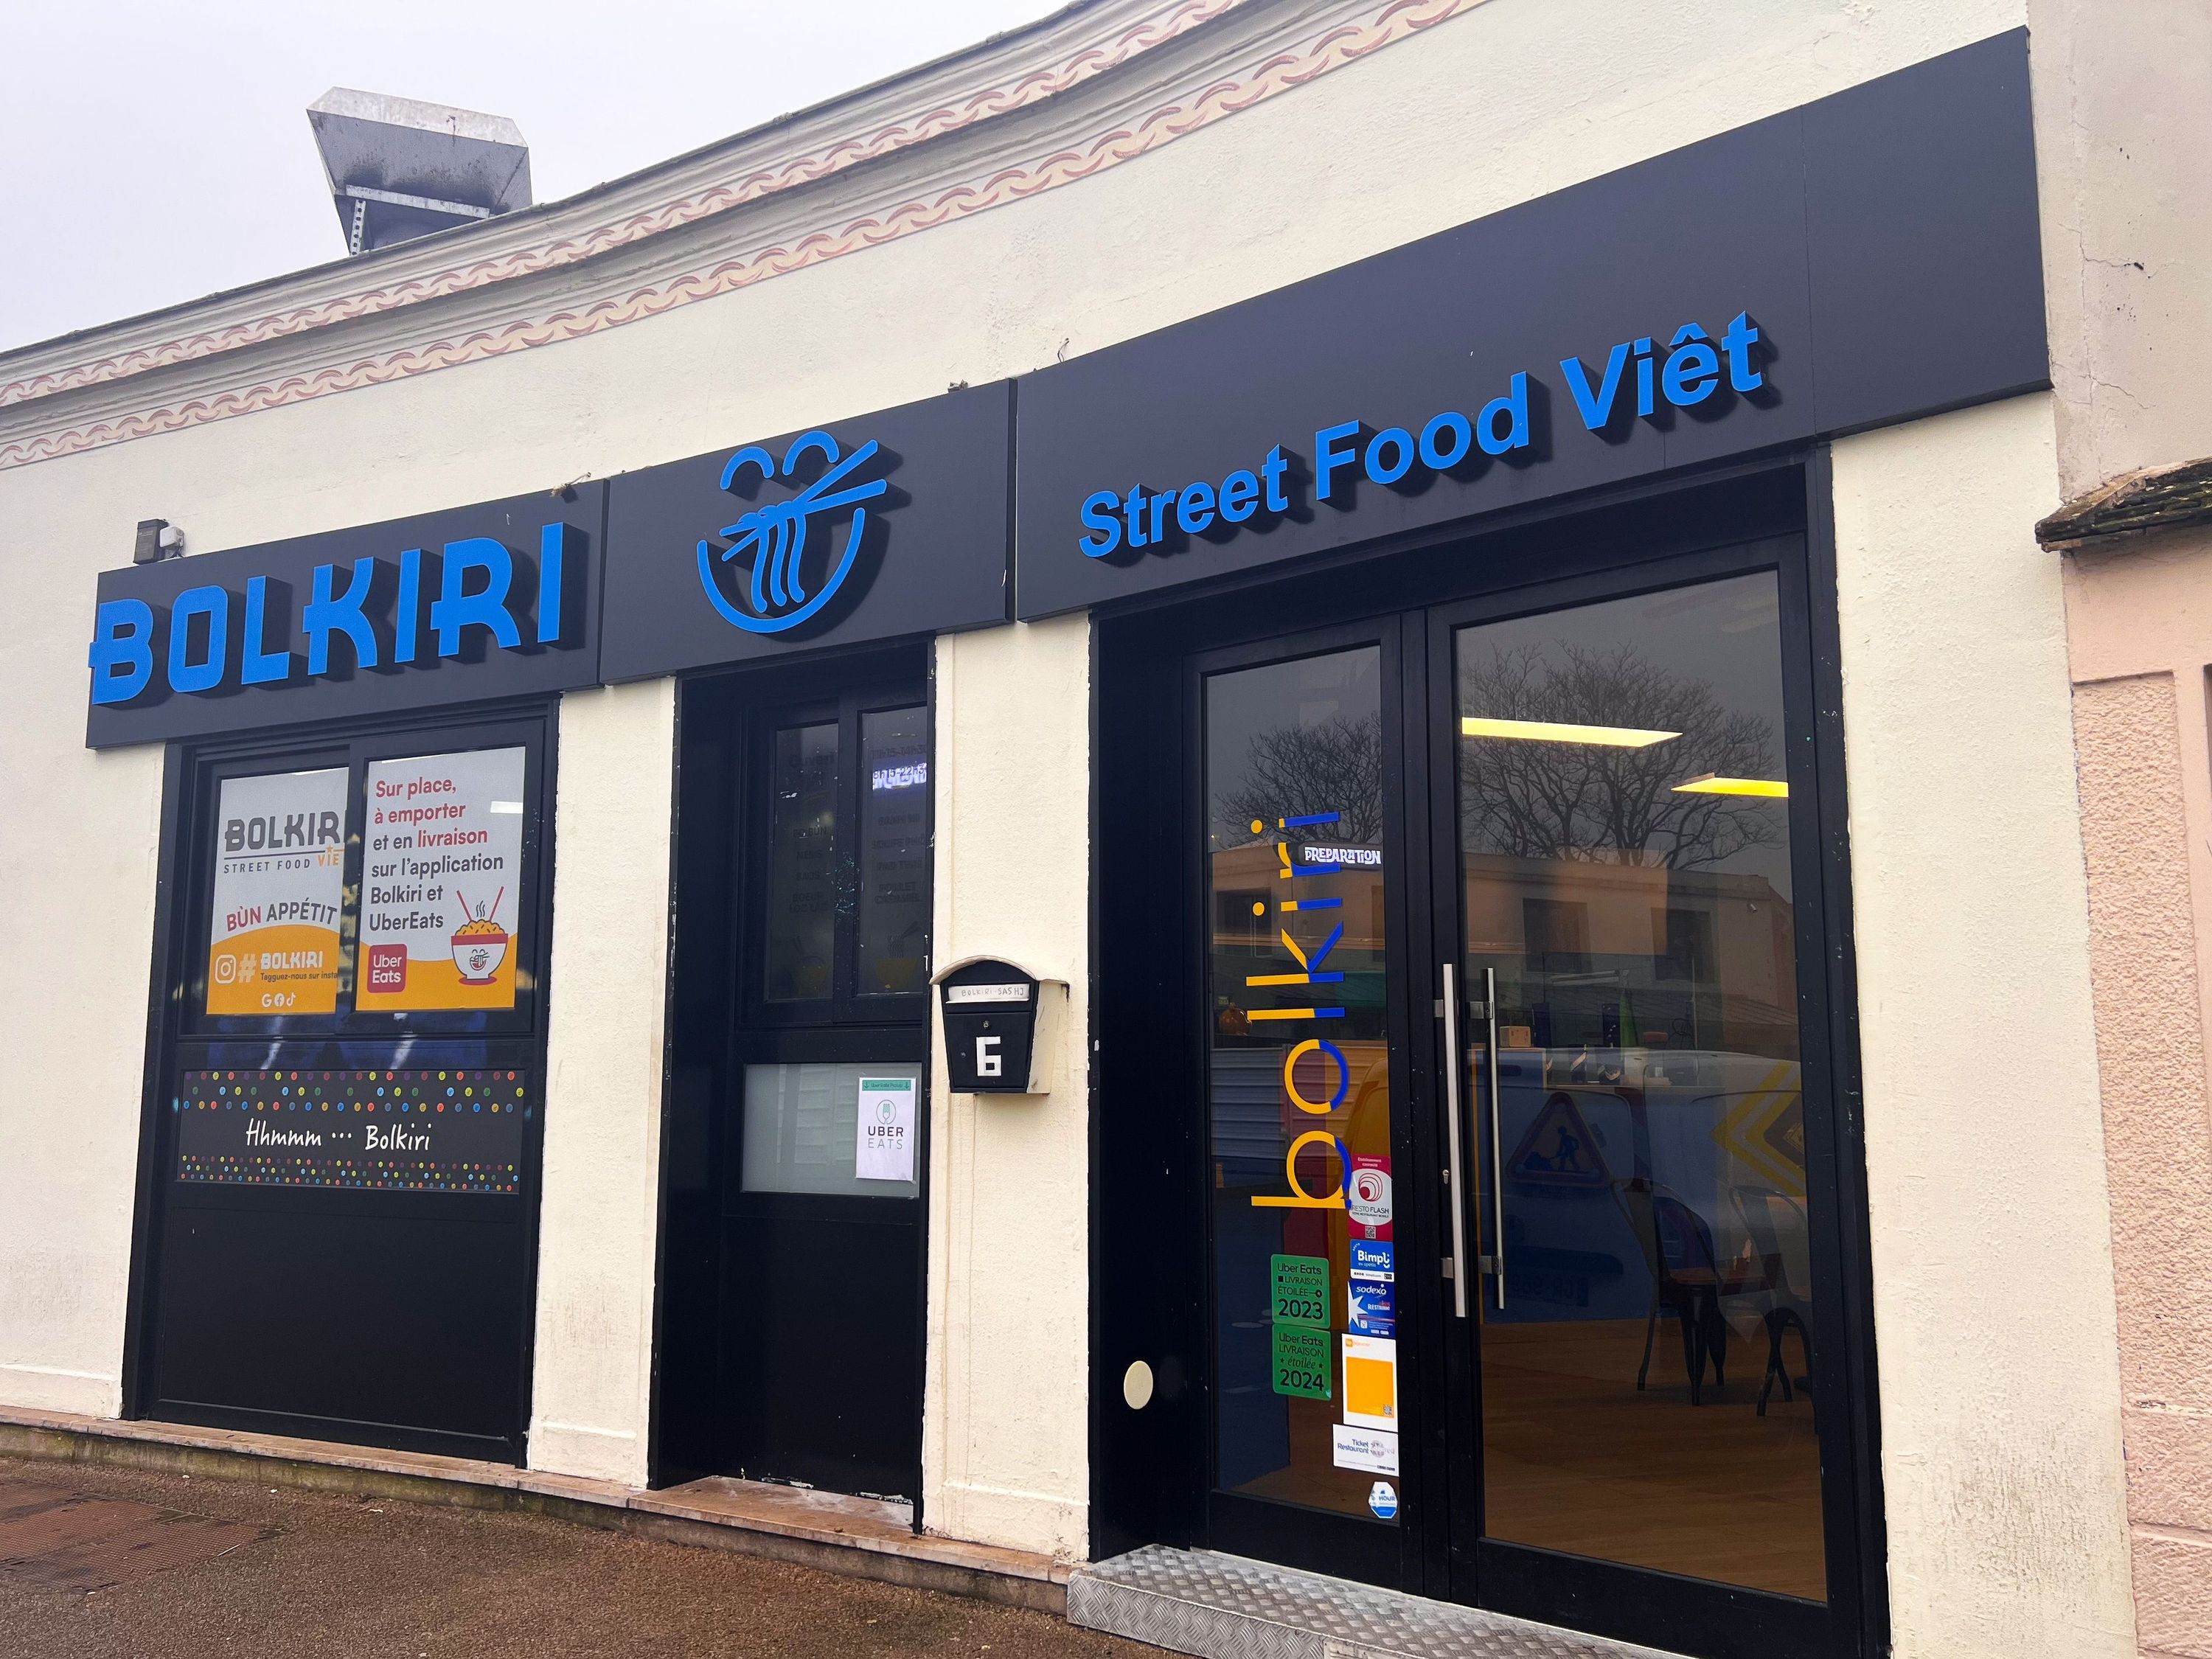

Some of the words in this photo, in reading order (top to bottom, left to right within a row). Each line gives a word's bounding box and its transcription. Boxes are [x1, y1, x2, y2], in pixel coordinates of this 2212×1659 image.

[1079, 443, 1287, 558] Street
[1315, 370, 1530, 501] Food
[1560, 310, 1762, 431] Viêt
[88, 521, 564, 705] BOLKIRI
[375, 779, 403, 798] Sur
[407, 776, 456, 800] place,
[374, 807, 383, 824] à
[389, 803, 466, 826] emporter
[225, 811, 341, 852] BOLKIR
[373, 834, 389, 851] et
[393, 834, 413, 849] en
[417, 827, 488, 847] livraison
[1304, 846, 1382, 864] PREPARATION
[223, 861, 270, 874] STREET
[277, 858, 310, 870] FOOD
[371, 863, 397, 877] sur
[370, 884, 422, 904] Bolkiri
[427, 885, 443, 901] et
[226, 906, 261, 932] BÙN
[266, 897, 338, 925] APPÉTIT
[369, 911, 444, 931] UberEats
[260, 950, 323, 970] BOLKIRI
[372, 955, 403, 968] Uber
[260, 973, 307, 983] Tagguez-nous
[372, 970, 401, 984] Eats
[1245, 811, 1353, 1209] bolkiri
[975, 1036, 1002, 1077] 6
[246, 1117, 321, 1147] Hhmmm
[364, 1123, 432, 1151] Bolkiri
[868, 1126, 904, 1137] UBER
[868, 1138, 903, 1150] EATS
[1352, 1204, 1369, 1213] RESTO
[1370, 1206, 1389, 1214] FLASH
[1357, 1250, 1390, 1266] Bimpli
[1277, 1262, 1298, 1273] Uber
[1300, 1264, 1322, 1275] Eats
[1284, 1275, 1323, 1287] LIVRAISON
[1278, 1285, 1309, 1297] ÉTOILÉE
[1355, 1284, 1387, 1295] sodexo
[1278, 1298, 1324, 1320] 2023
[1279, 1332, 1300, 1343] Uber
[1301, 1335, 1324, 1346] Eats
[1279, 1343, 1324, 1357] LIVRAISON
[1287, 1355, 1316, 1369] étoilée
[1279, 1368, 1324, 1391] 2024
[1337, 1443, 1369, 1454] Restaurant
[1352, 1439, 1369, 1448] Ticket
